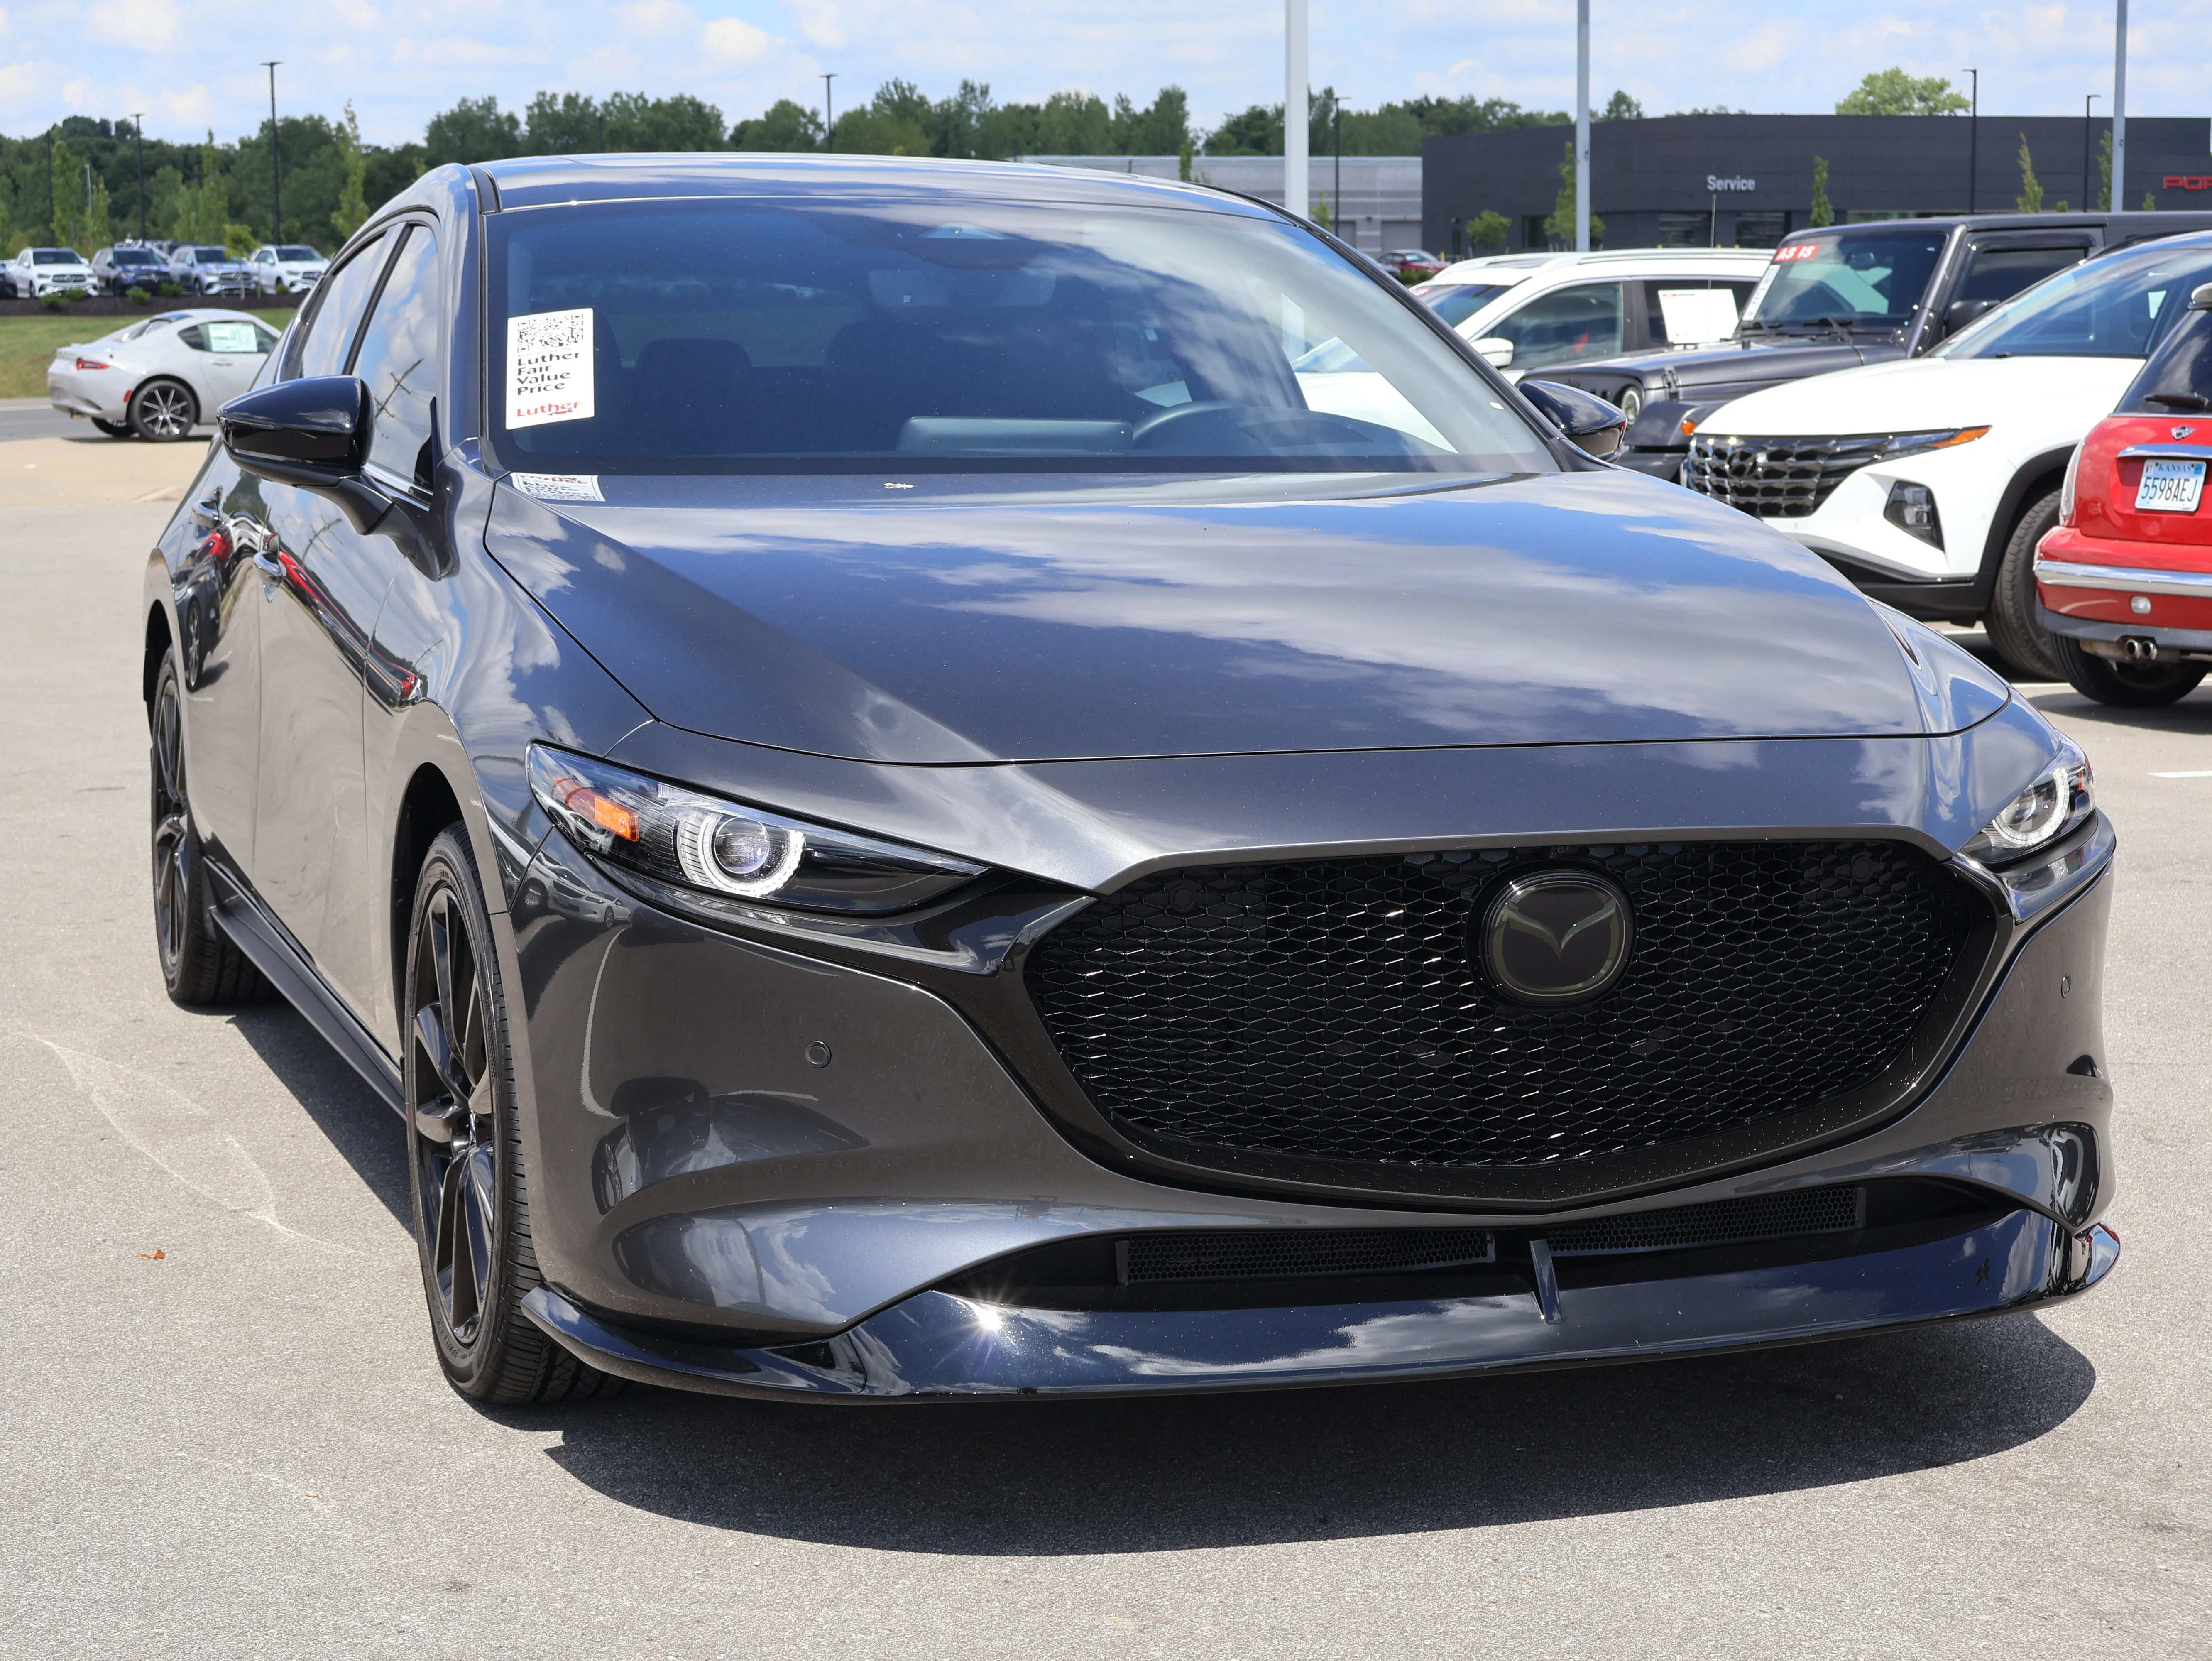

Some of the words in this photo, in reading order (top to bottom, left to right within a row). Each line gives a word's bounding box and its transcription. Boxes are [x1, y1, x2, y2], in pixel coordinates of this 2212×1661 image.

[1706, 174, 1756, 191] Service
[1776, 247, 1797, 260] AS
[1796, 245, 1815, 259] IS
[518, 352, 581, 366] Luther
[518, 364, 552, 376] Fair
[516, 372, 571, 385] Value
[517, 383, 565, 395] Price
[517, 402, 580, 416] Luther
[2159, 463, 2192, 473] KANSAS
[2141, 477, 2198, 502] 5598AEJ
